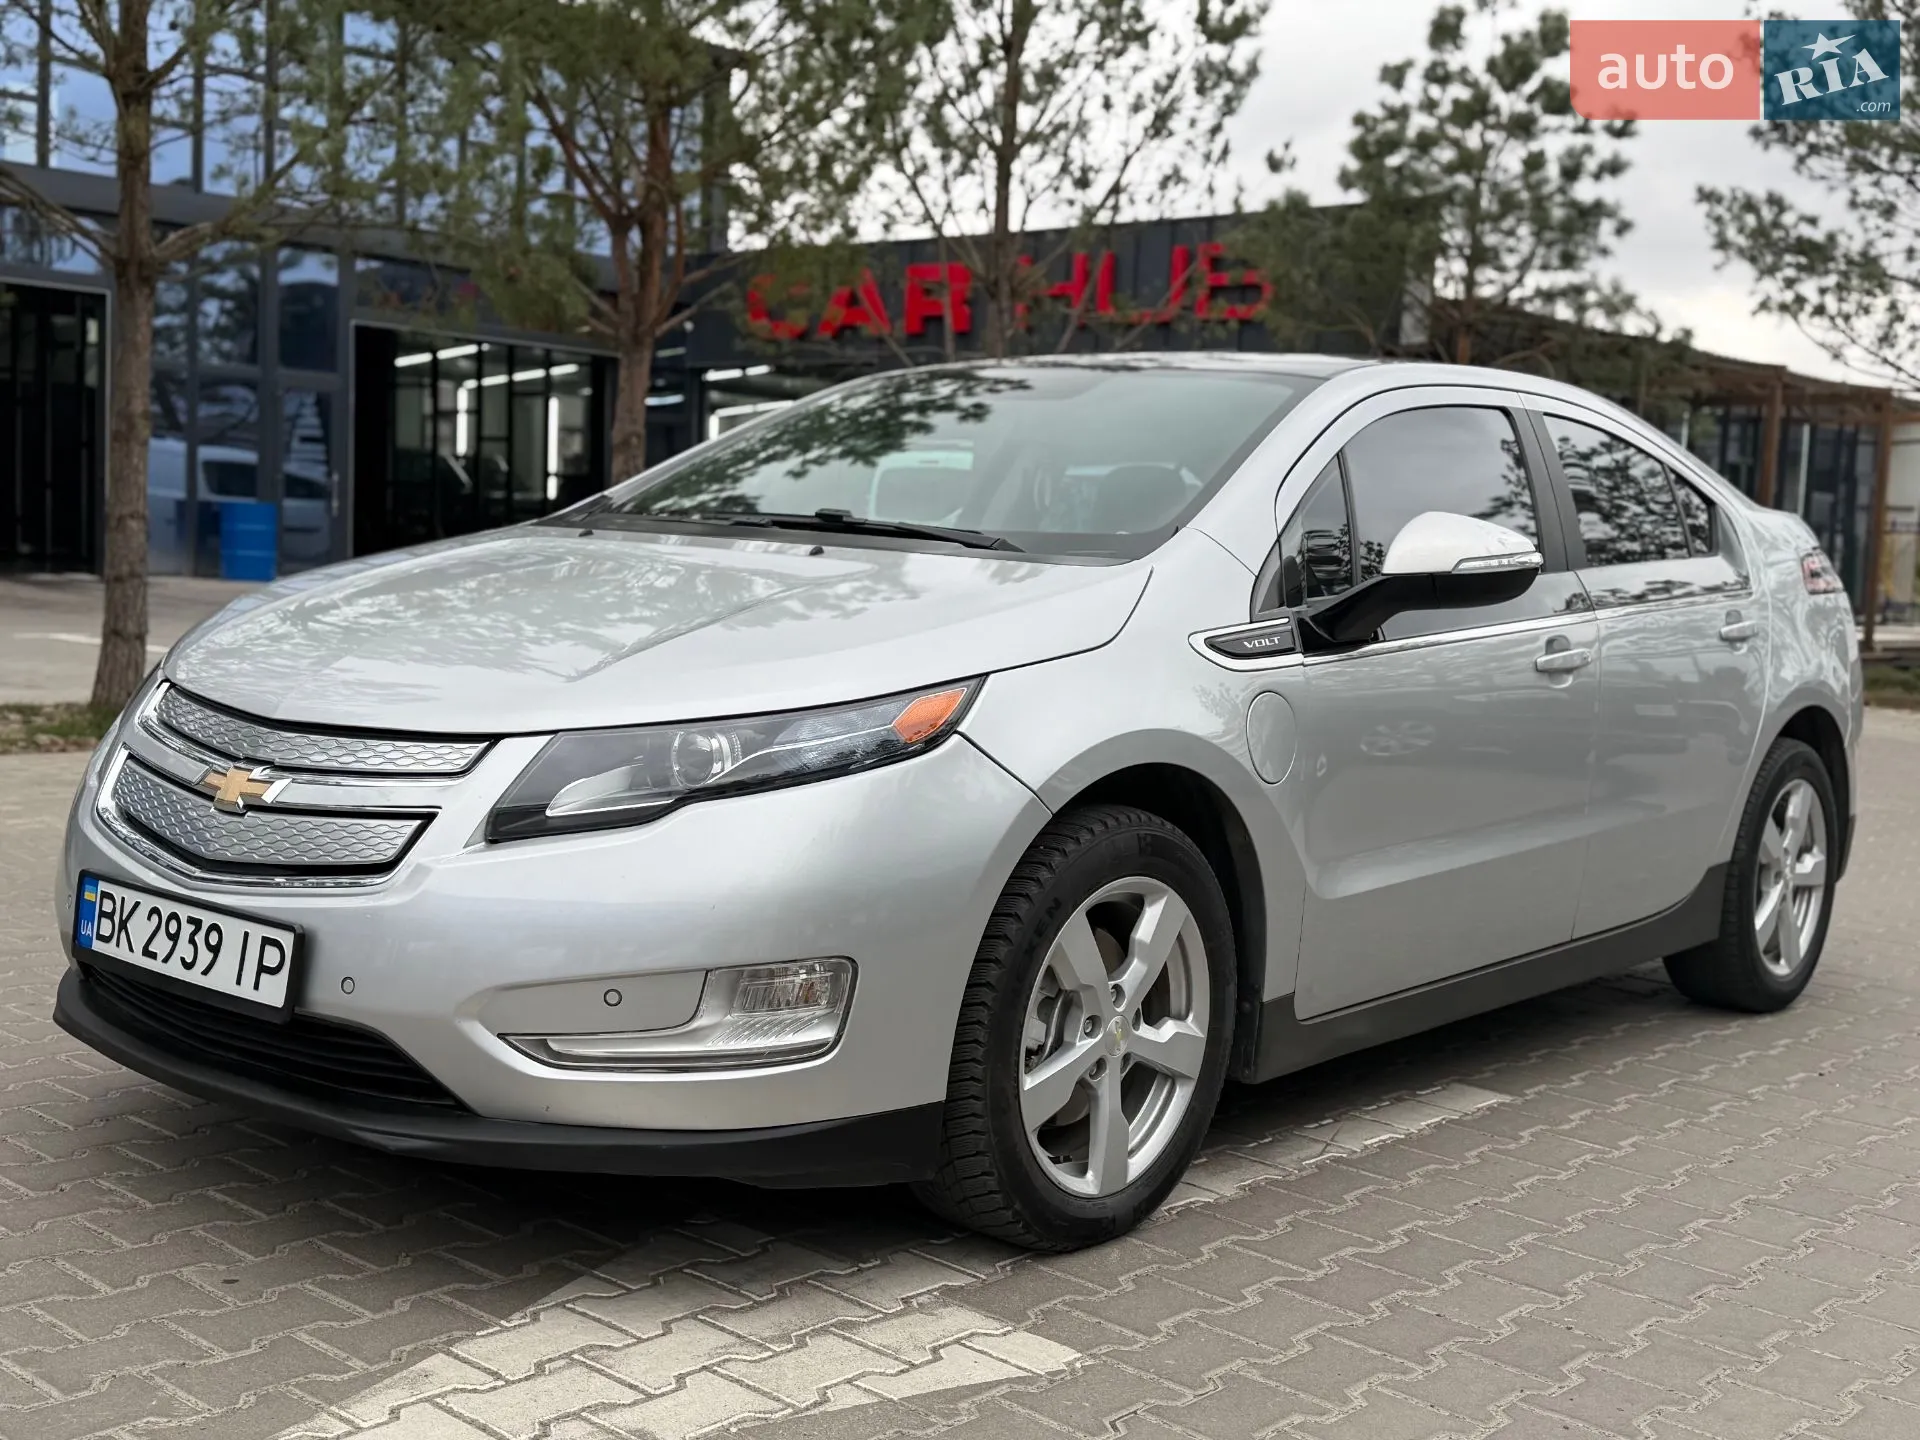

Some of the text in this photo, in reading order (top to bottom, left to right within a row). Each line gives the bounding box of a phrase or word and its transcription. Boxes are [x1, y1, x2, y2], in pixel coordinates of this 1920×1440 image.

[746, 242, 1274, 341] CAR HUB
[1243, 636, 1281, 649] VOLT
[80, 919, 93, 938] UA
[95, 889, 286, 991] BK 2939 IP
